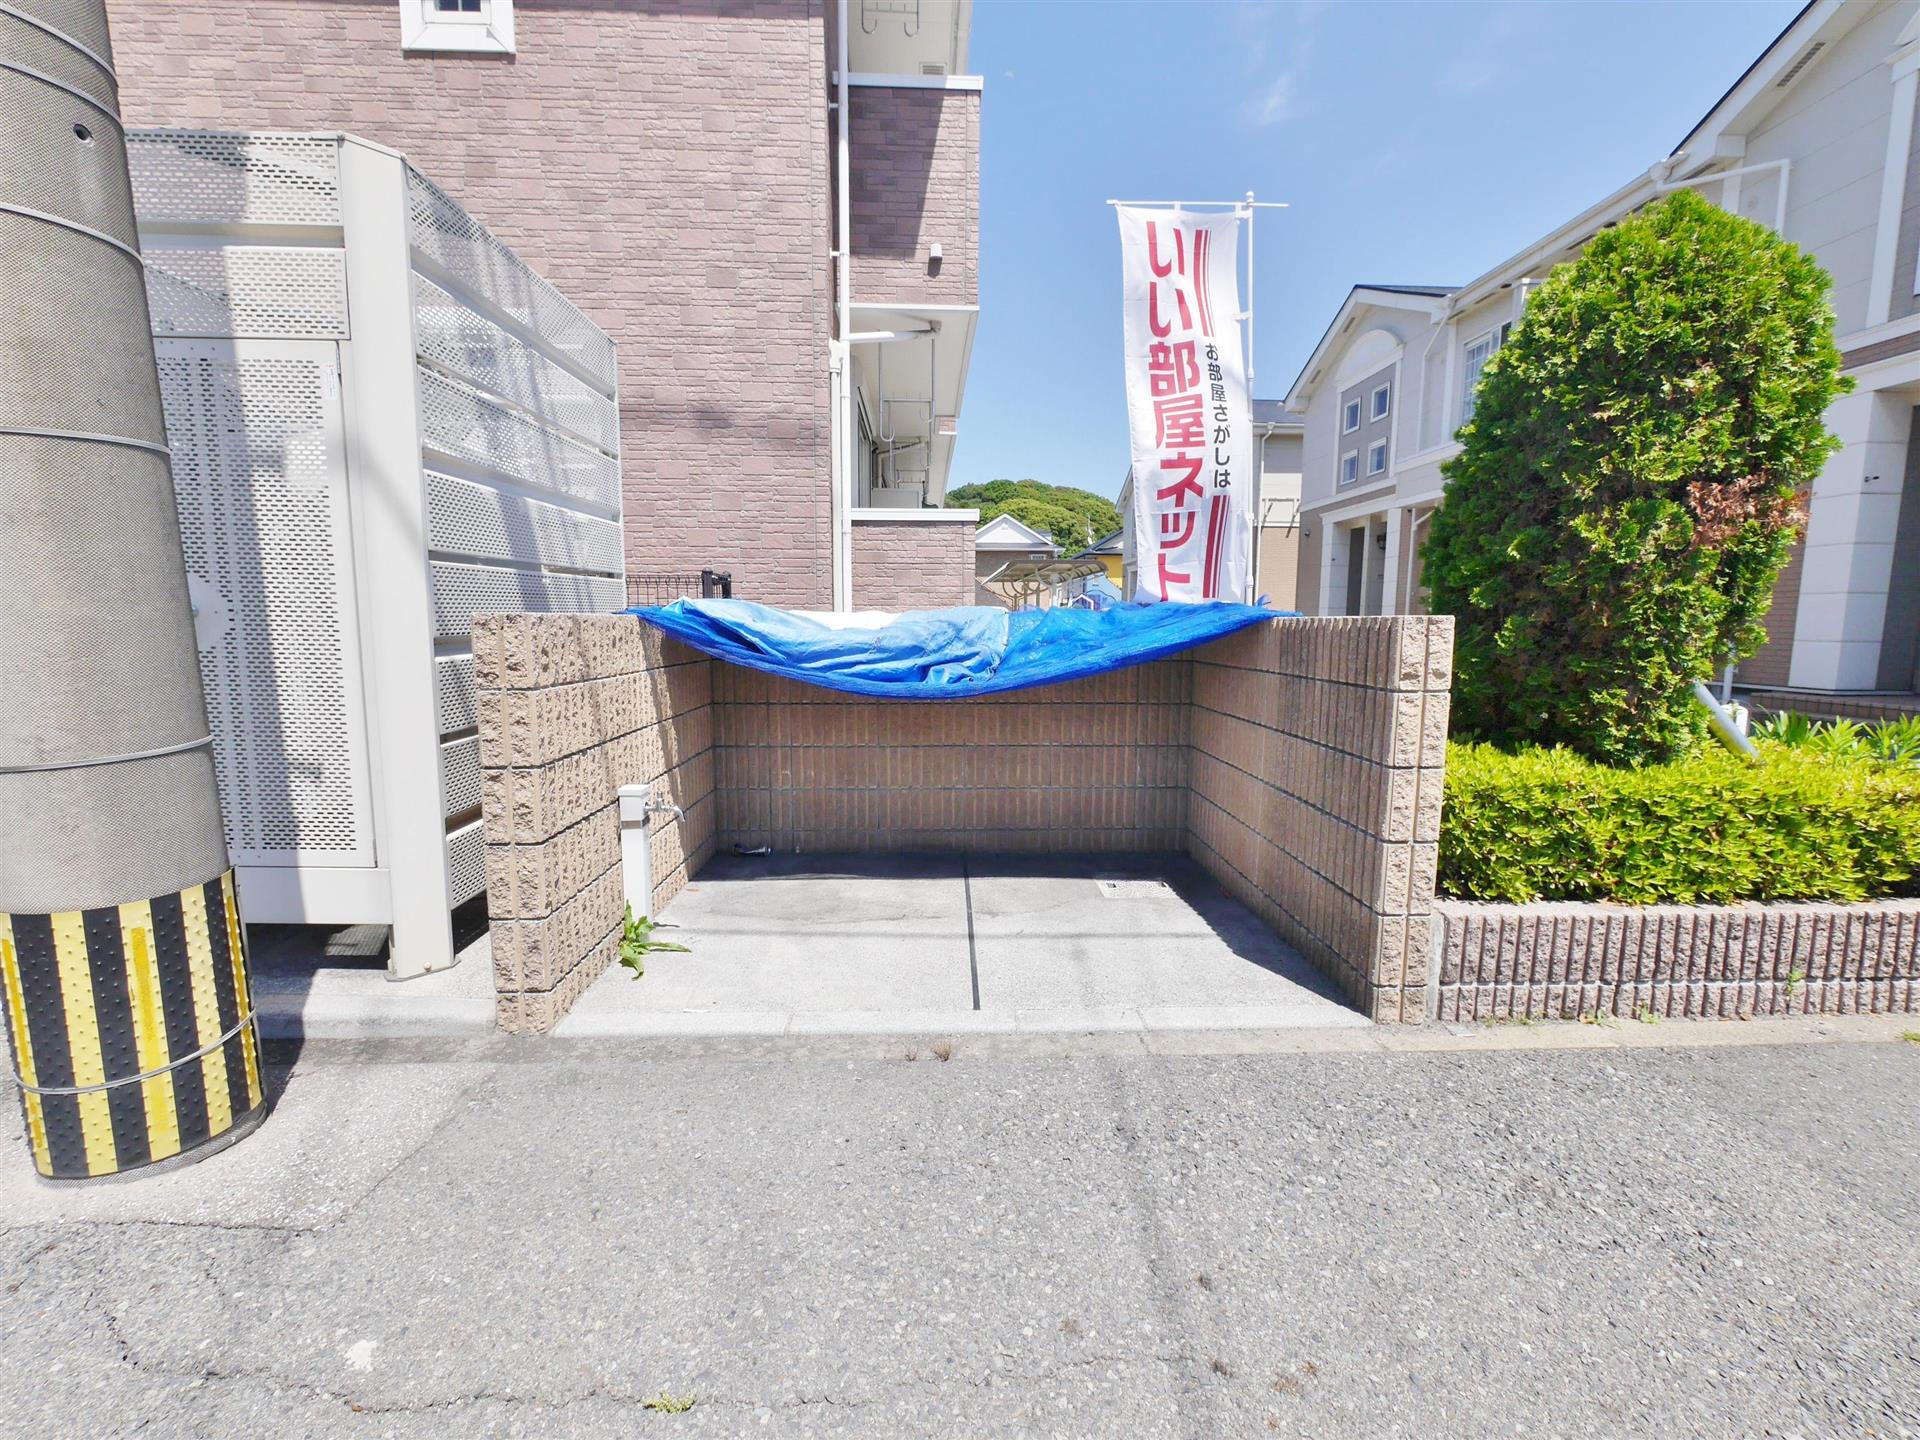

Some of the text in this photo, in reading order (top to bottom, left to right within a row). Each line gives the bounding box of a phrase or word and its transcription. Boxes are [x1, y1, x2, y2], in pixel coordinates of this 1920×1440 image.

[1146, 221, 1206, 602] いい部屋ネット
[1205, 343, 1231, 488] お部屋さがしは
